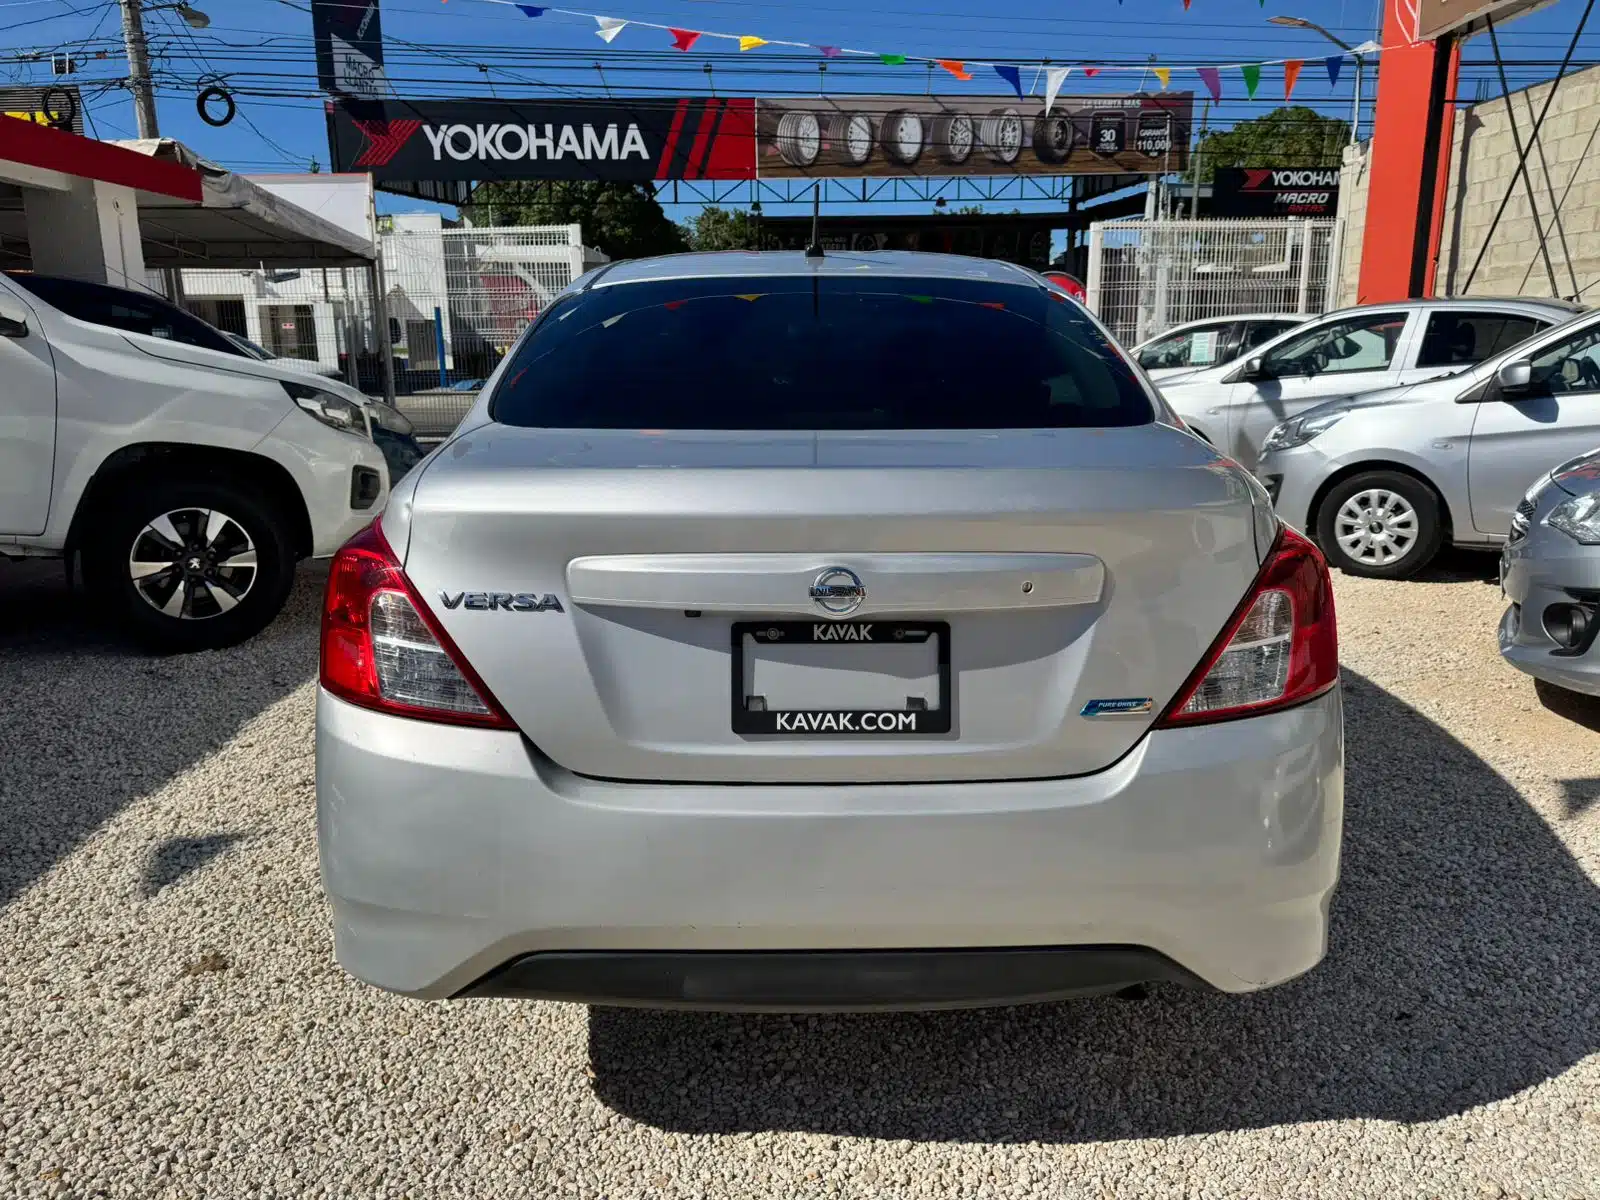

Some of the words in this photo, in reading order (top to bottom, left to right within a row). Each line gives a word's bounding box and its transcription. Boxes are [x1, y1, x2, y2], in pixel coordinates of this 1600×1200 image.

[422, 123, 650, 161] YOKOHAMA
[1100, 129, 1116, 142] 30
[1274, 193, 1329, 204] MACRO
[813, 586, 866, 598] NISSAN
[438, 590, 565, 613] VERSA
[813, 624, 873, 641] KAVAK
[776, 712, 916, 731] KAVAK.COM
